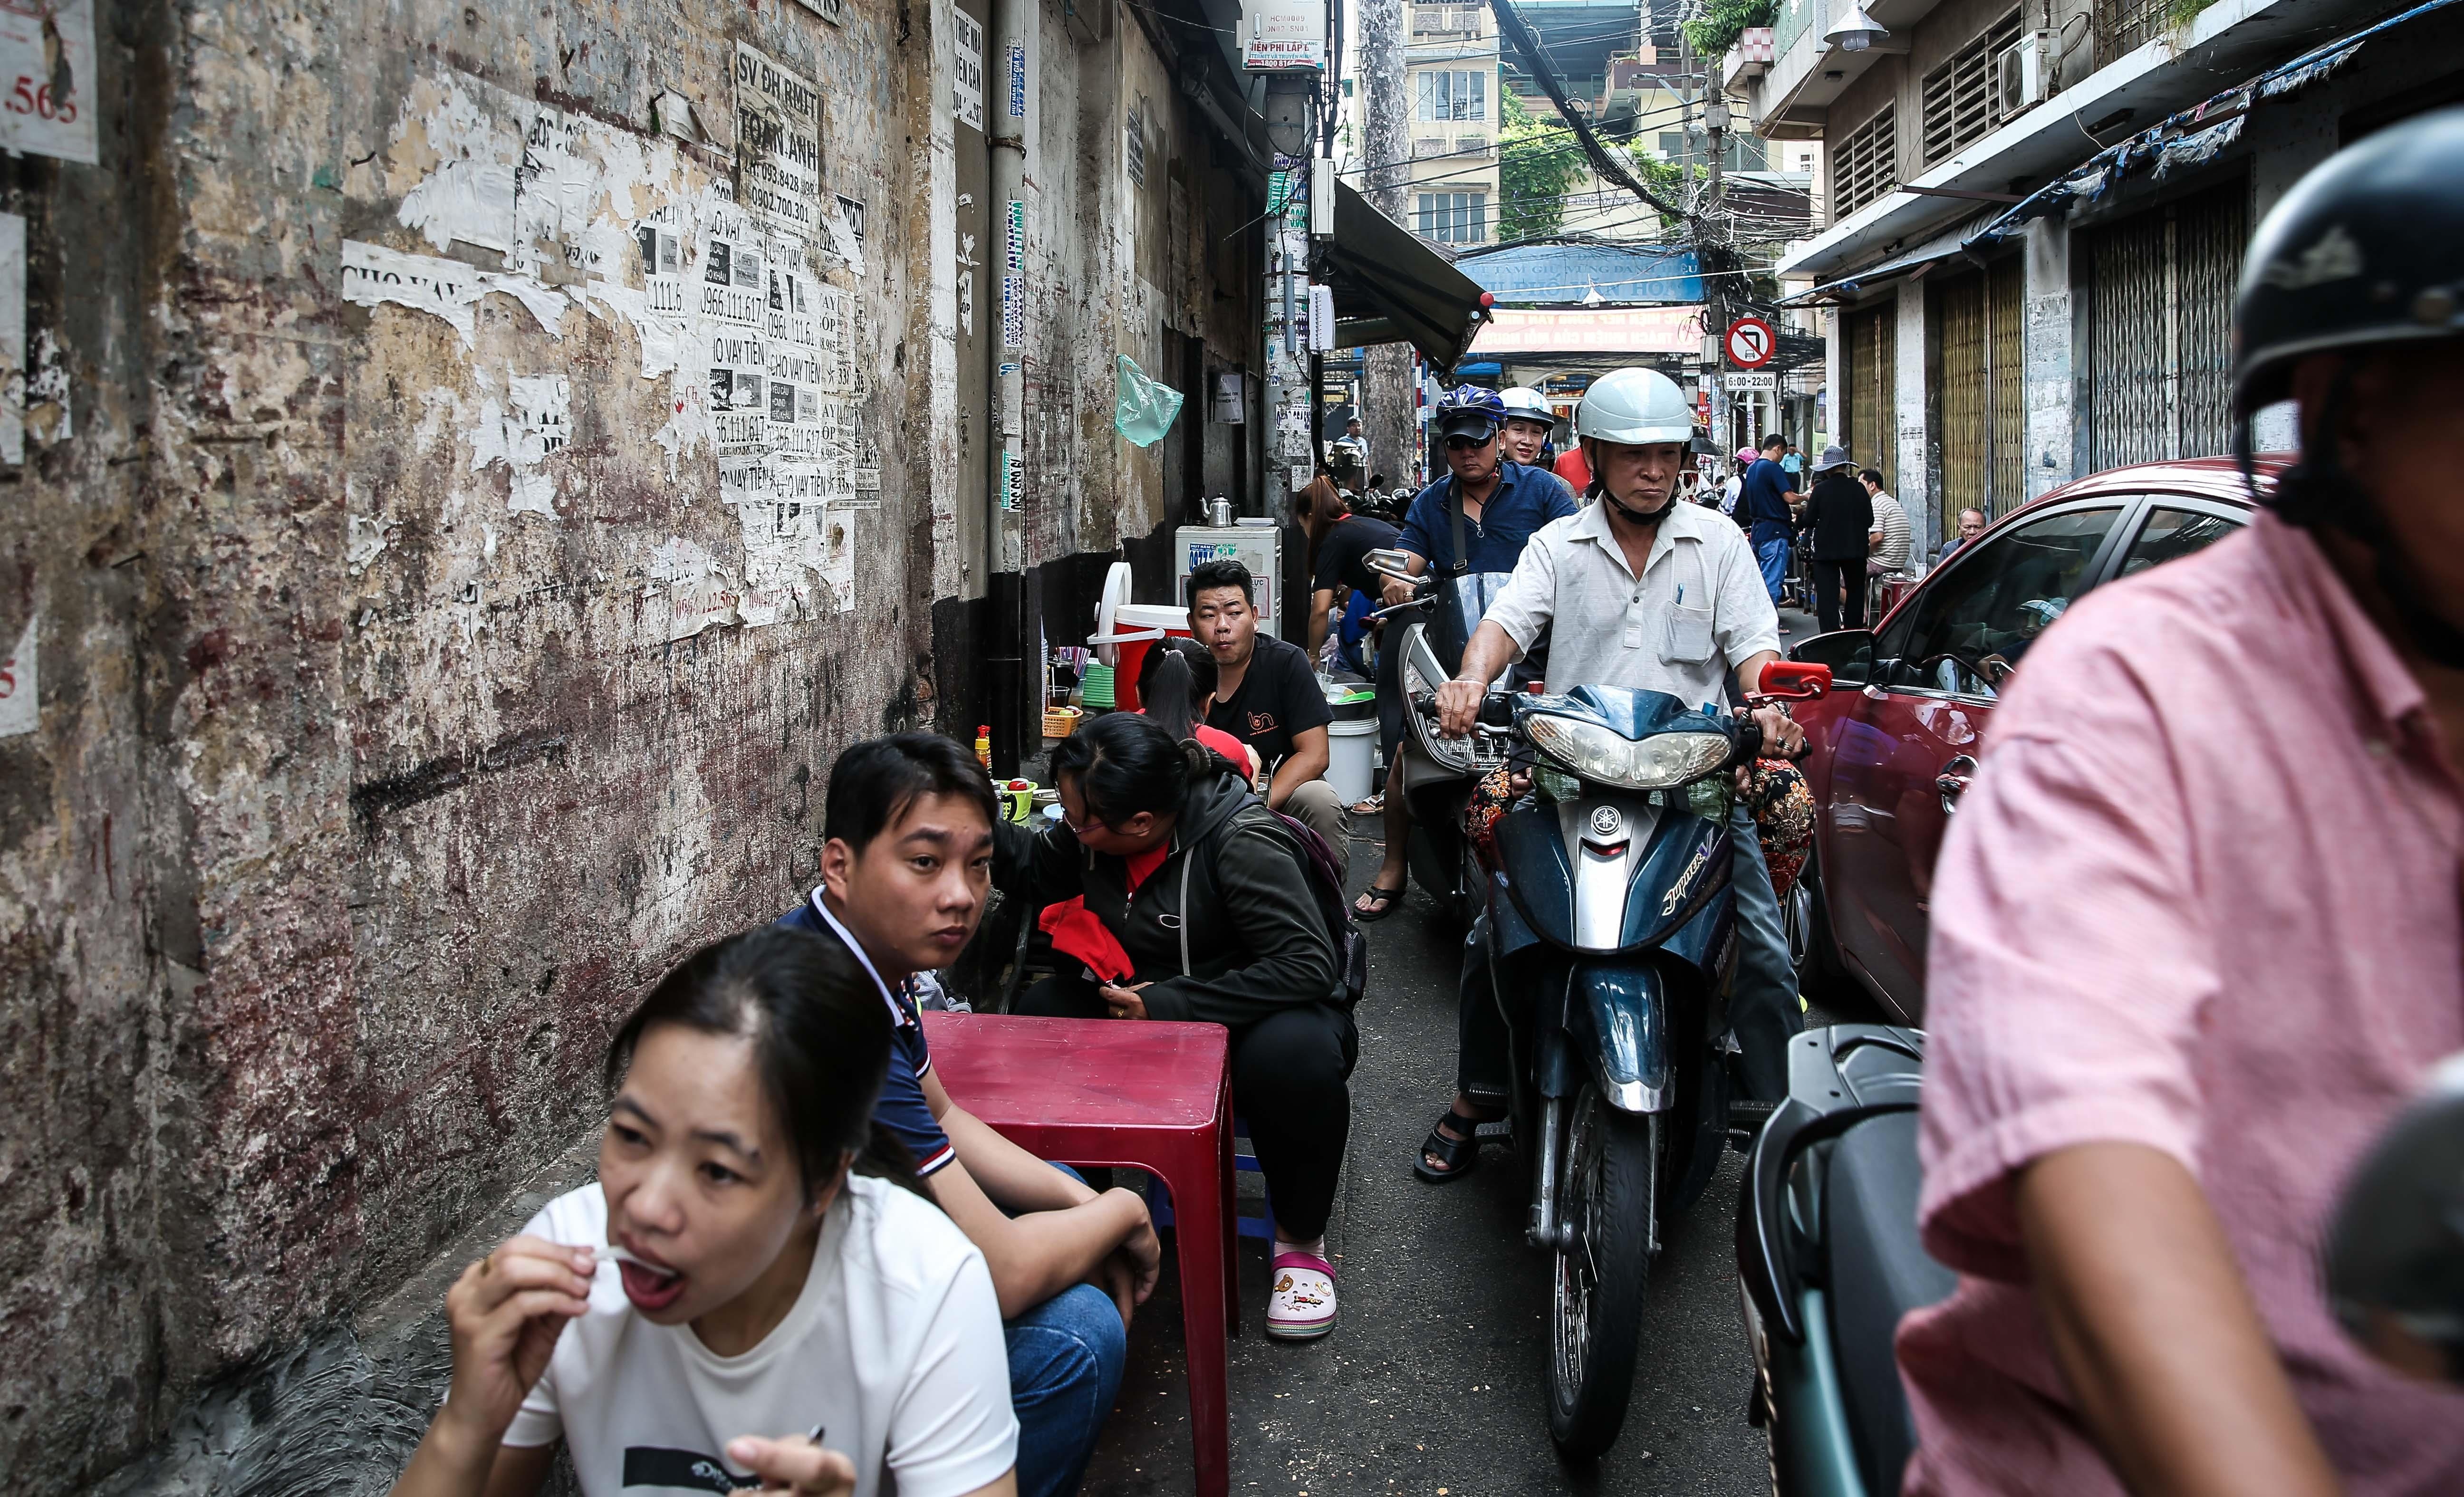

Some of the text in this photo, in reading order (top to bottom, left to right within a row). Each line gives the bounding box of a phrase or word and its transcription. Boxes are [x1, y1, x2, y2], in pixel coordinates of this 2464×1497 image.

[955, 17, 982, 57] THUÊ NHÀ
[739, 52, 817, 118] SV ĐH RMIT
[969, 61, 981, 94] CĂN
[789, 247, 802, 272] VAY
[725, 338, 742, 364] VAY
[744, 332, 765, 365] TIỀN
[789, 357, 803, 381] VAY
[804, 353, 820, 384] TIỀN
[795, 475, 808, 497] VAY
[810, 467, 826, 497] TIỀN
